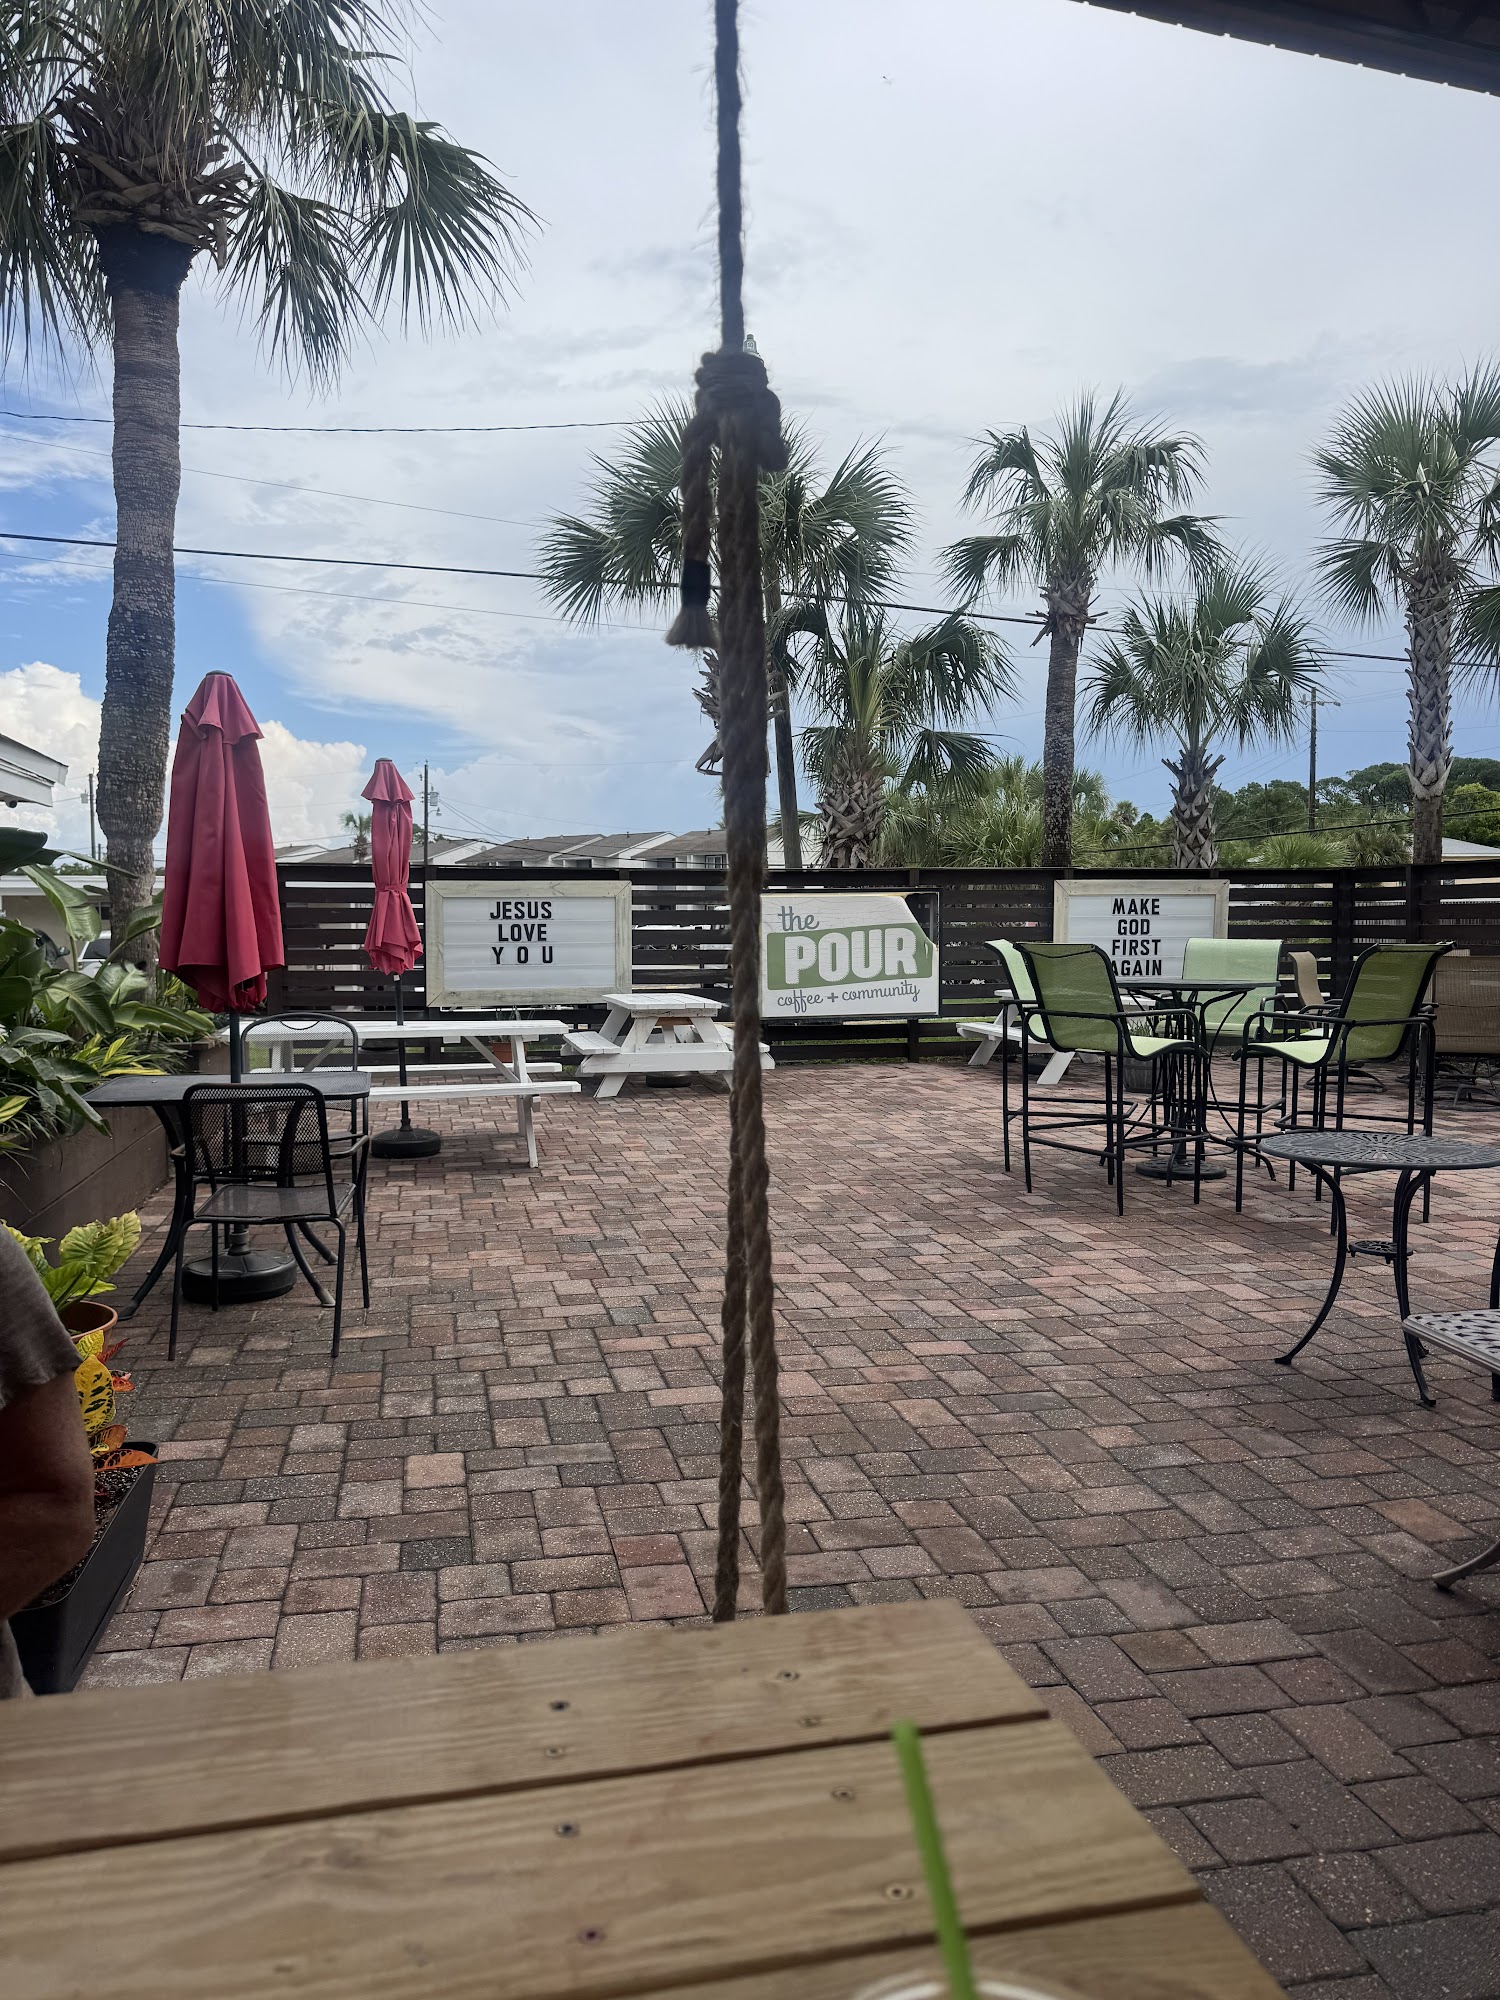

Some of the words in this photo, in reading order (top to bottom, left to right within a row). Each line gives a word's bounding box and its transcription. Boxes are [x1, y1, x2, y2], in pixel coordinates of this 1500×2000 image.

[490, 901, 552, 920] JESUS
[1112, 898, 1160, 915] MAKE
[777, 905, 820, 931] the
[1117, 918, 1151, 936] GOD
[498, 923, 547, 942] LOVE
[784, 927, 918, 985] POUR
[1112, 939, 1162, 956] FIRST
[1111, 959, 1162, 976] AGAIN
[777, 989, 824, 1014] coffee
[842, 979, 921, 1003] community
